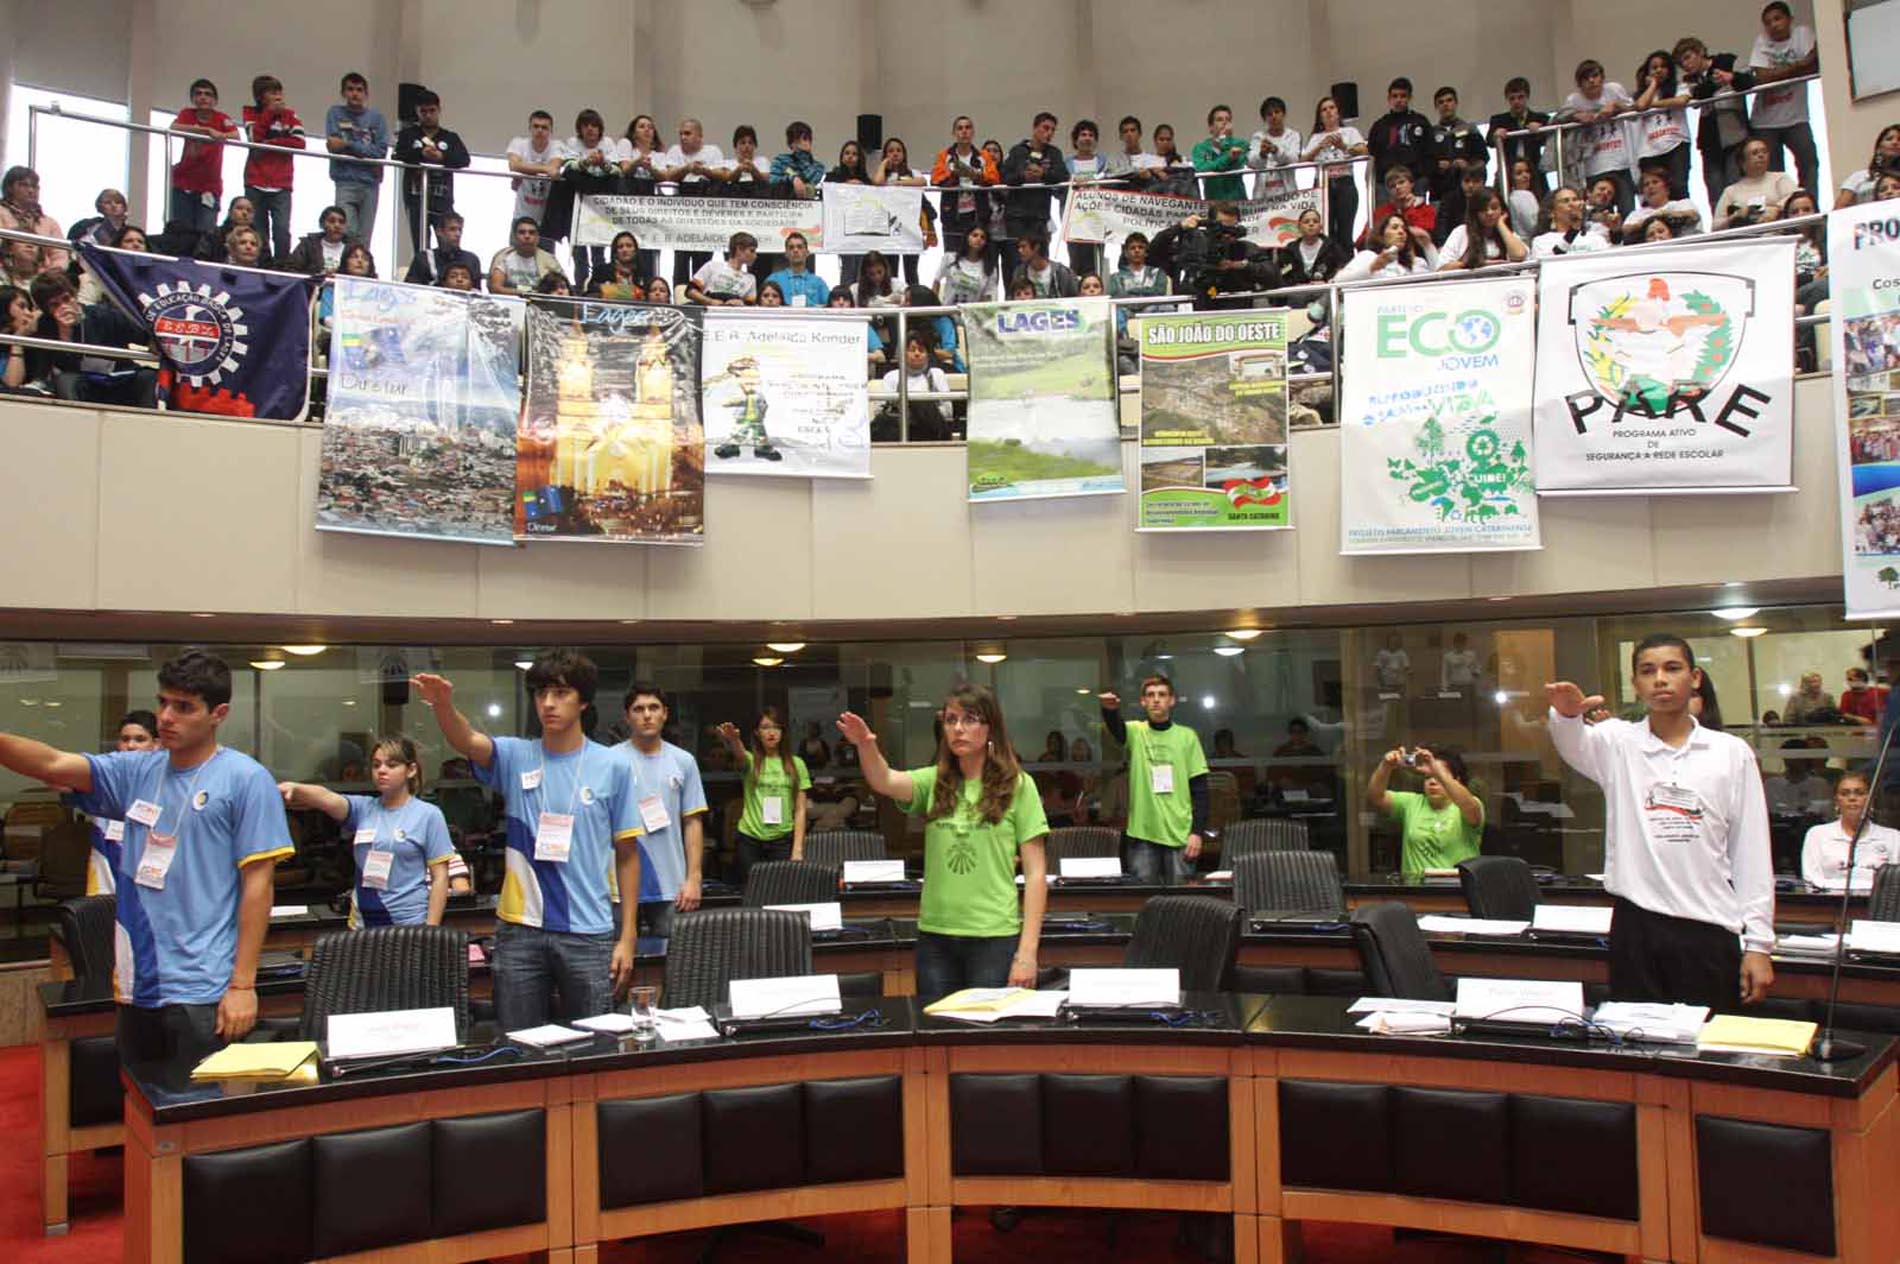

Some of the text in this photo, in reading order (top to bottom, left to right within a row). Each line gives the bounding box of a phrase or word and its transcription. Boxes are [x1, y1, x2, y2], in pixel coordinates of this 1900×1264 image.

[707, 198, 728, 208] QUE
[730, 199, 749, 209] TEM
[1122, 193, 1136, 203] DE
[1140, 196, 1210, 211] NAVEGANTE
[611, 216, 625, 225] DE
[996, 309, 1081, 333] LAGES
[1148, 322, 1281, 344] SÃO JOÃO DO OESTE
[1376, 308, 1502, 359] ECO
[1564, 383, 1773, 438] PARE
[1612, 427, 1697, 438] PROGRAMA ATIVO
[1647, 439, 1660, 449] DE
[1586, 451, 1643, 463] SEGURANÇA
[1653, 450, 1677, 460] REDE
[1679, 449, 1724, 459] ESCOLAR
